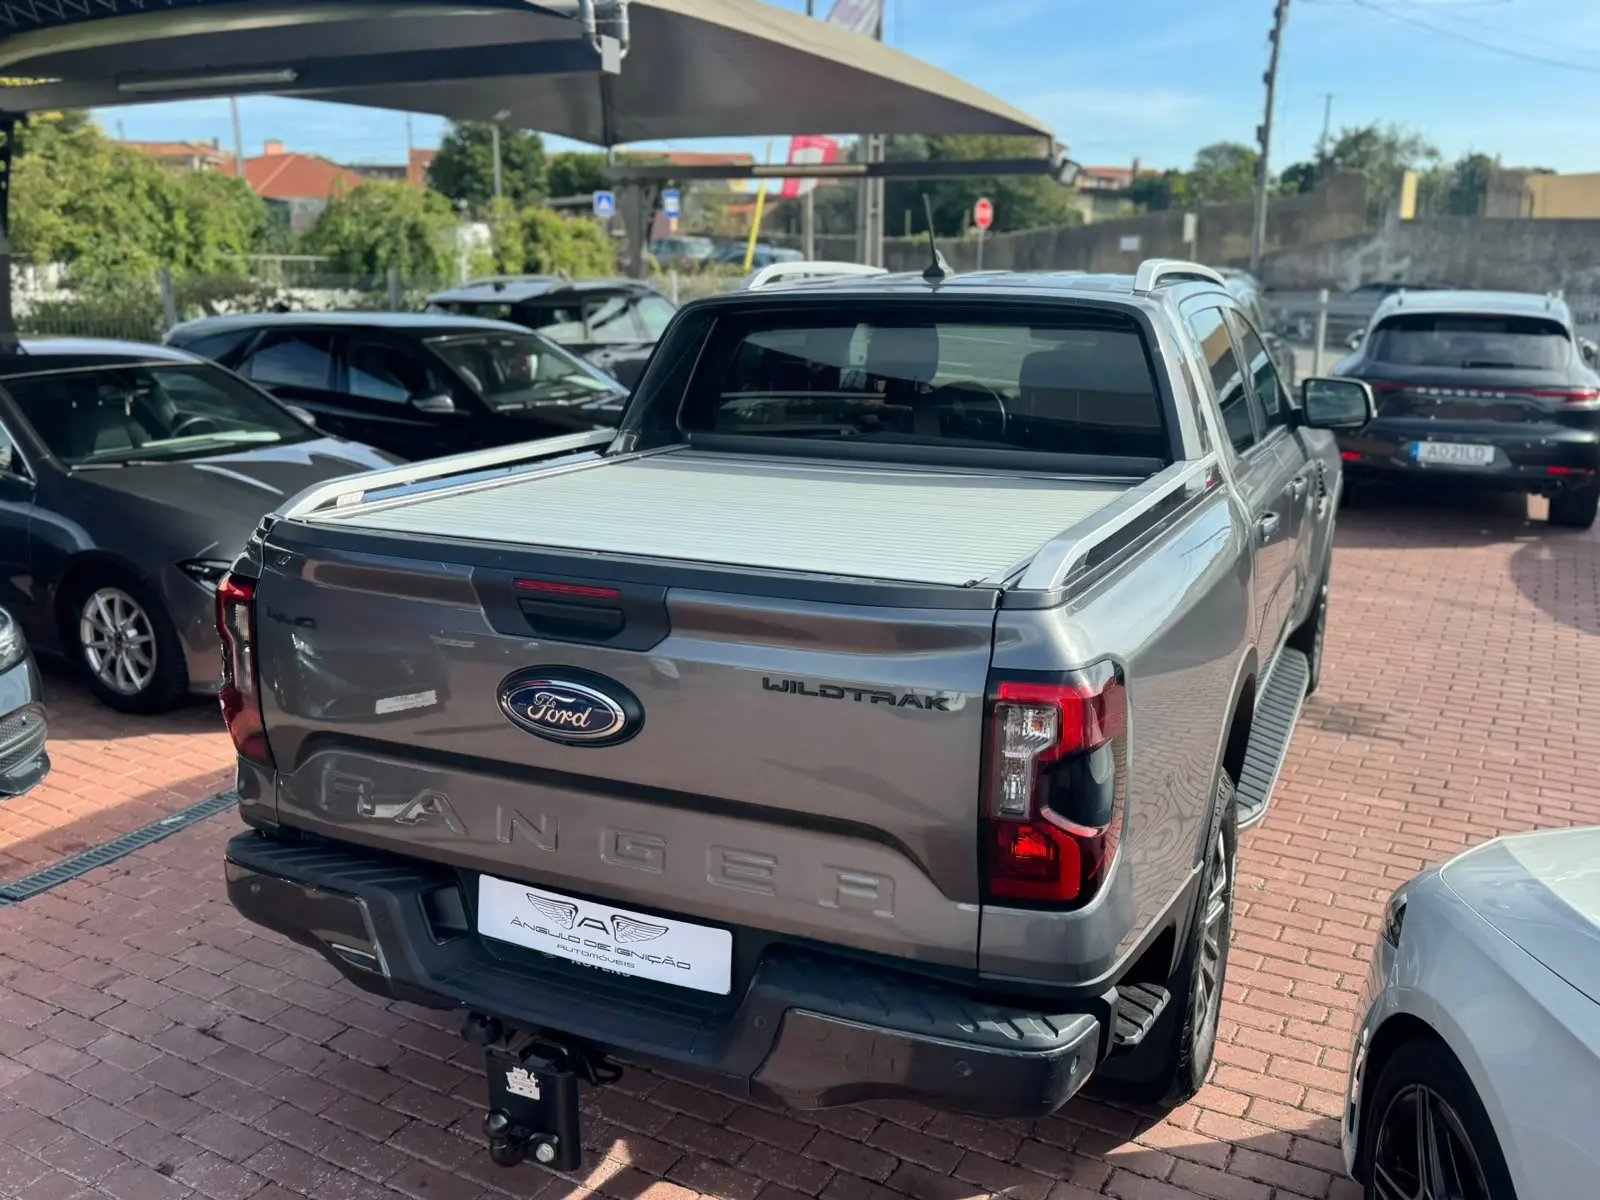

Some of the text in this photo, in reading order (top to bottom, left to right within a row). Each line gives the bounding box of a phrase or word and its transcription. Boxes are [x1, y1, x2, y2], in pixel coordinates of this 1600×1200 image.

[527, 692, 593, 728] Ford
[762, 676, 950, 711] WILDTRAK
[319, 767, 897, 919] RANGER
[510, 916, 581, 944] ÂNGULO
[584, 938, 612, 952] DE
[614, 946, 692, 970] IGNIÇÃO
[556, 943, 636, 969] AUTOMÓVEIS
